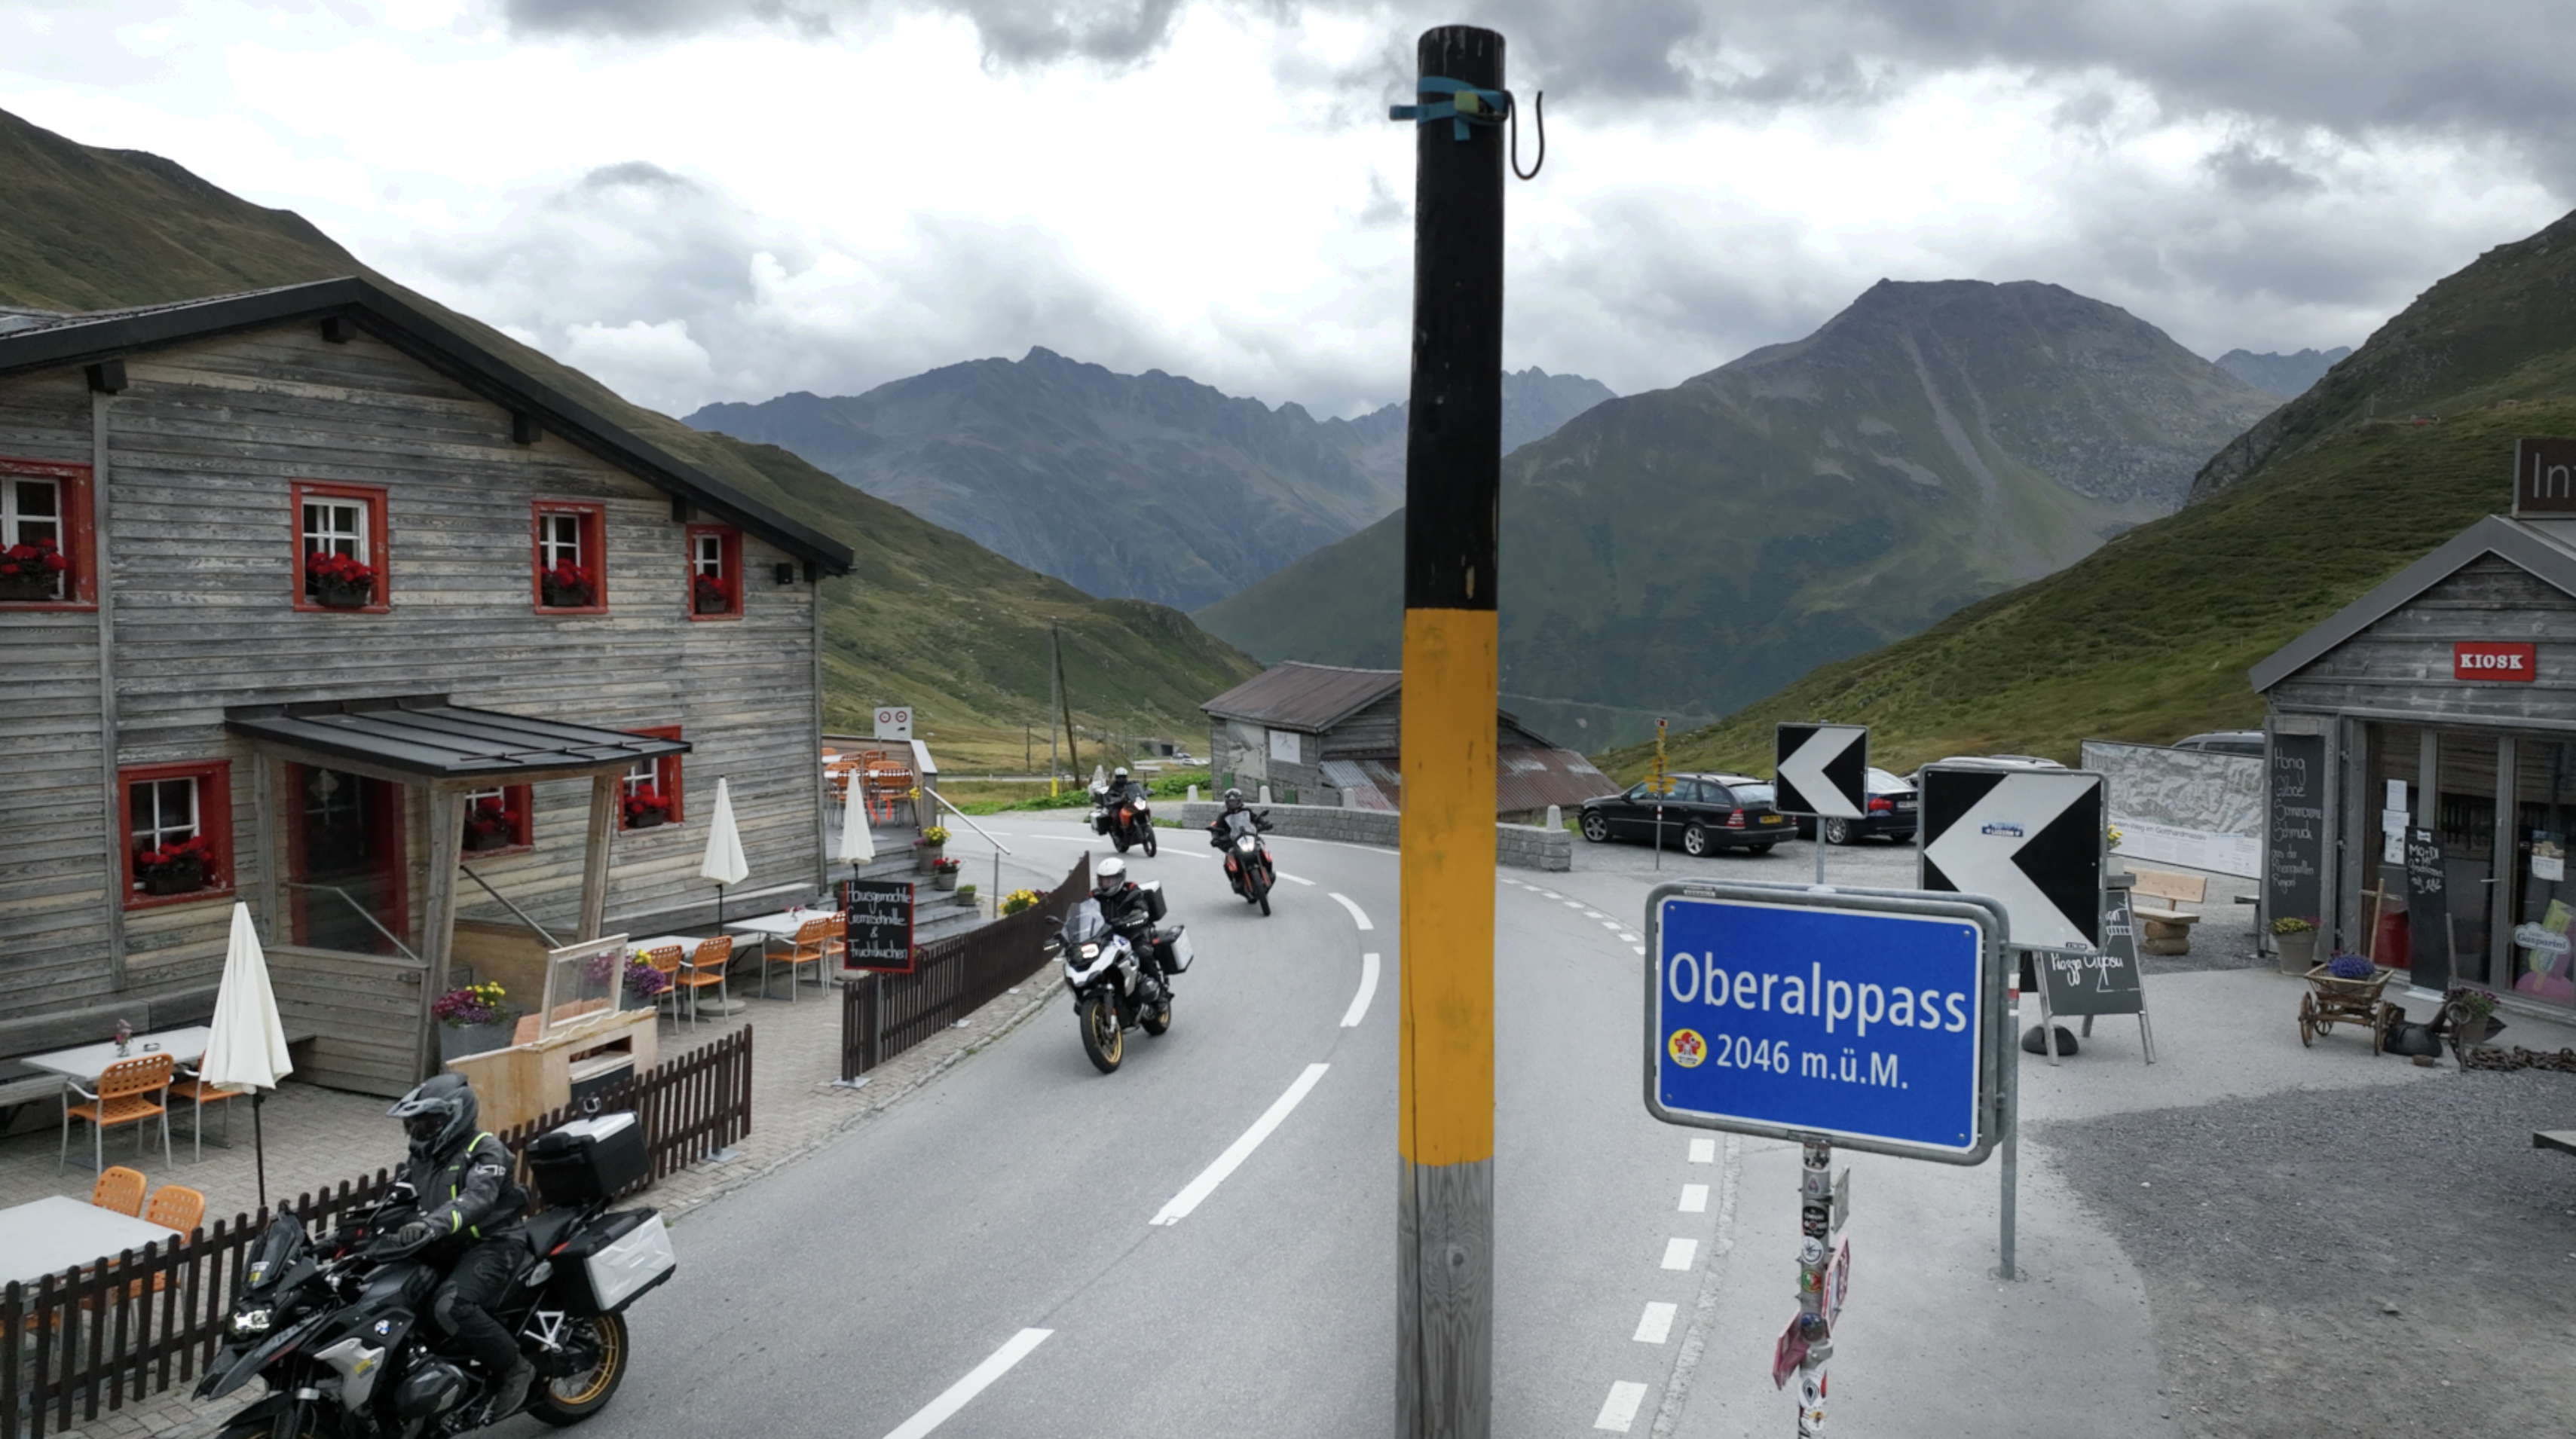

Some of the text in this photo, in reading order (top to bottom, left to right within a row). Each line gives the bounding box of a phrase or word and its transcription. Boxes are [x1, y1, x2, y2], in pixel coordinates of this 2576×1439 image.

[2534, 452, 2576, 498] In
[2460, 653, 2523, 670] KIOSK
[2274, 747, 2306, 786] Honig
[2516, 932, 2567, 949] Gasparini
[1669, 952, 1967, 1037] Oberalppass
[1716, 1034, 1908, 1089] 2046 m.ü.M.
